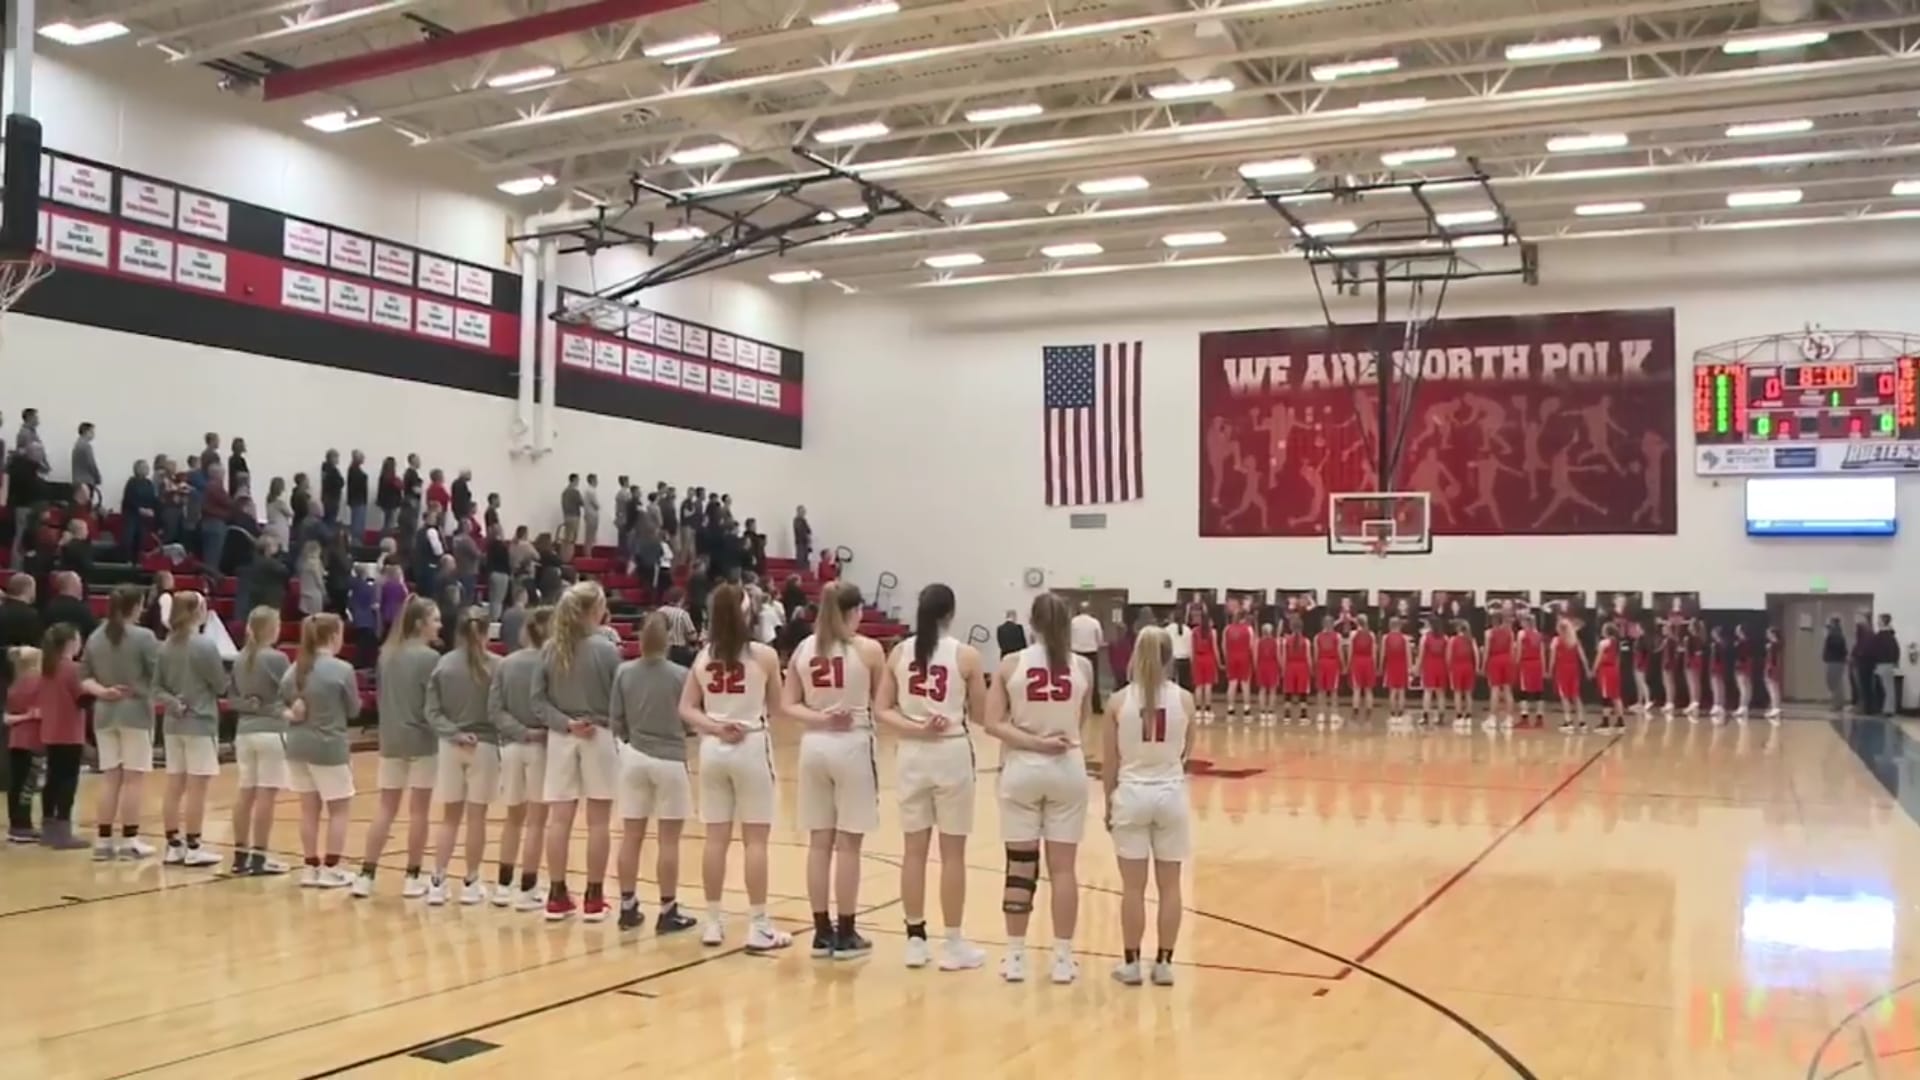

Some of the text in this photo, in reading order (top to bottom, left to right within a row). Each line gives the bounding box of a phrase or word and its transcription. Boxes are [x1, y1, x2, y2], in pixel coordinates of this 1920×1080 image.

[1224, 339, 1653, 393] WE ARE NORTH POLK
[1799, 365, 1853, 386] 8:00
[1765, 378, 1781, 399] 0
[1877, 374, 1894, 395] 0
[705, 662, 746, 694] 32
[809, 656, 845, 688] 21
[908, 660, 948, 702] 23
[1026, 667, 1072, 701] 25
[1140, 708, 1166, 742] 11
